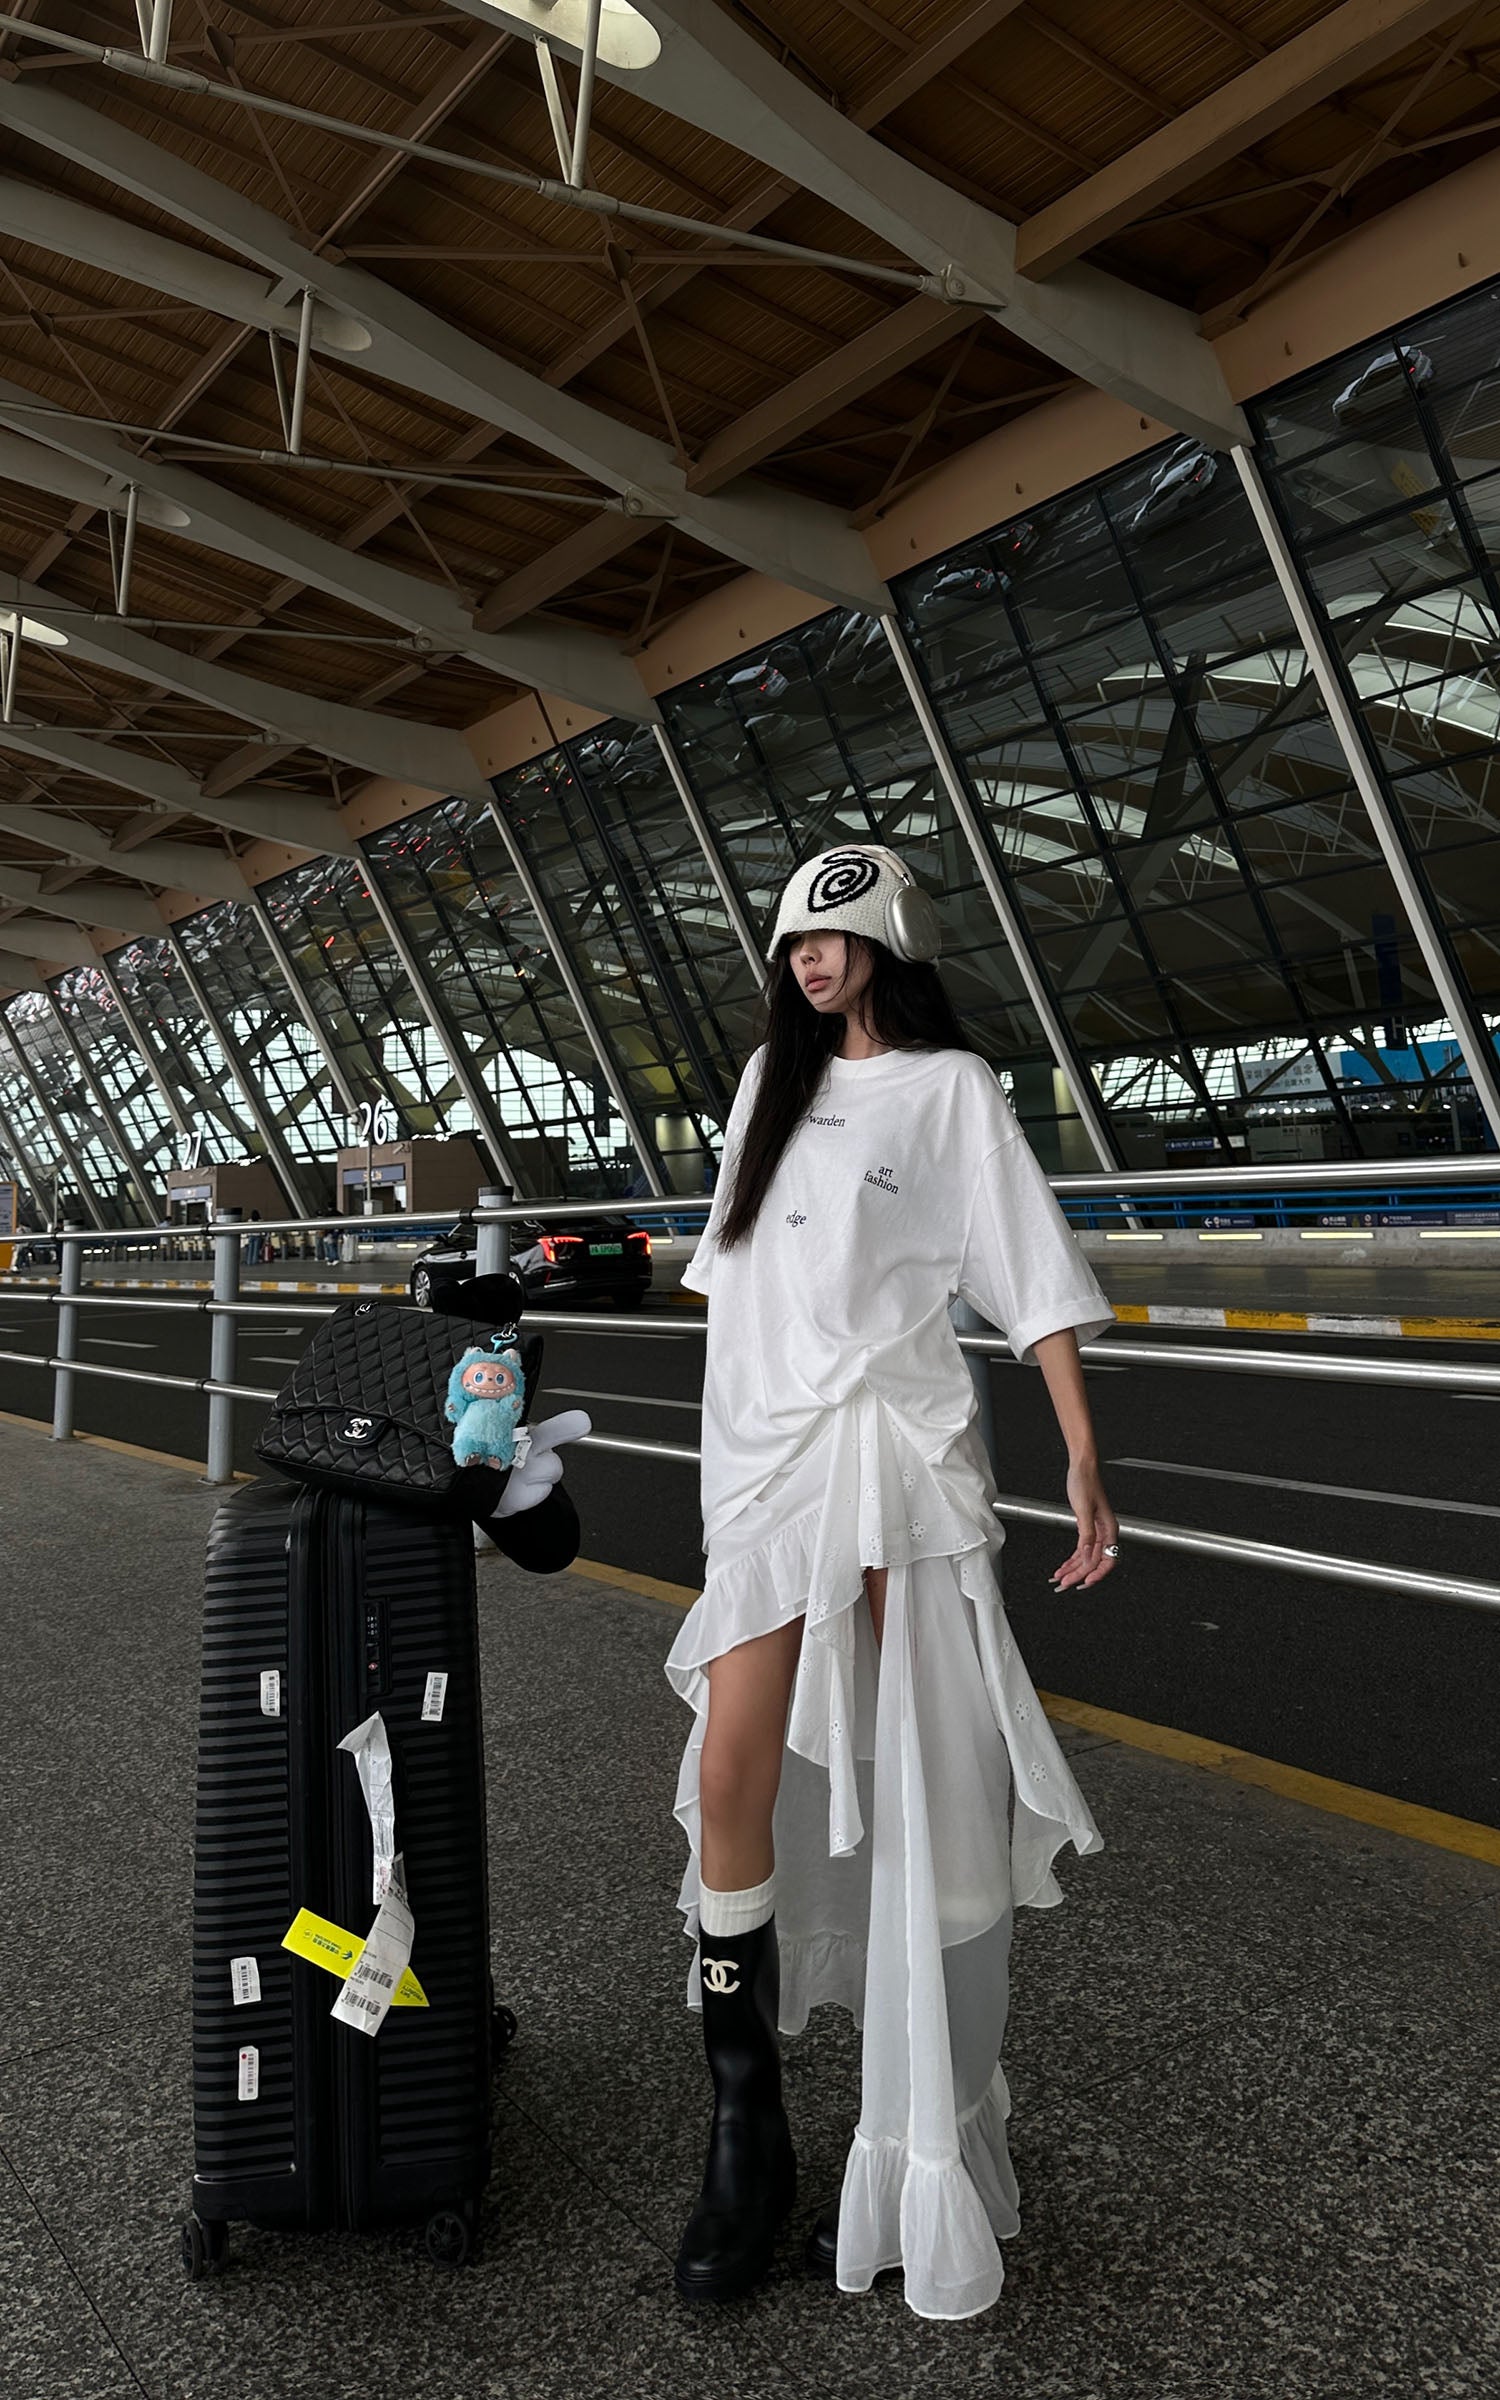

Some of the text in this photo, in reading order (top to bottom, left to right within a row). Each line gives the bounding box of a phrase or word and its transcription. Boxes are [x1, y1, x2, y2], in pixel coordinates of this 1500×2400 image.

[358, 1100, 388, 1147] 26
[809, 1115, 846, 1127] warden
[181, 1131, 202, 1171] 27
[878, 1166, 894, 1178] art
[864, 1171, 899, 1195] fashion
[785, 1210, 807, 1228] edge
